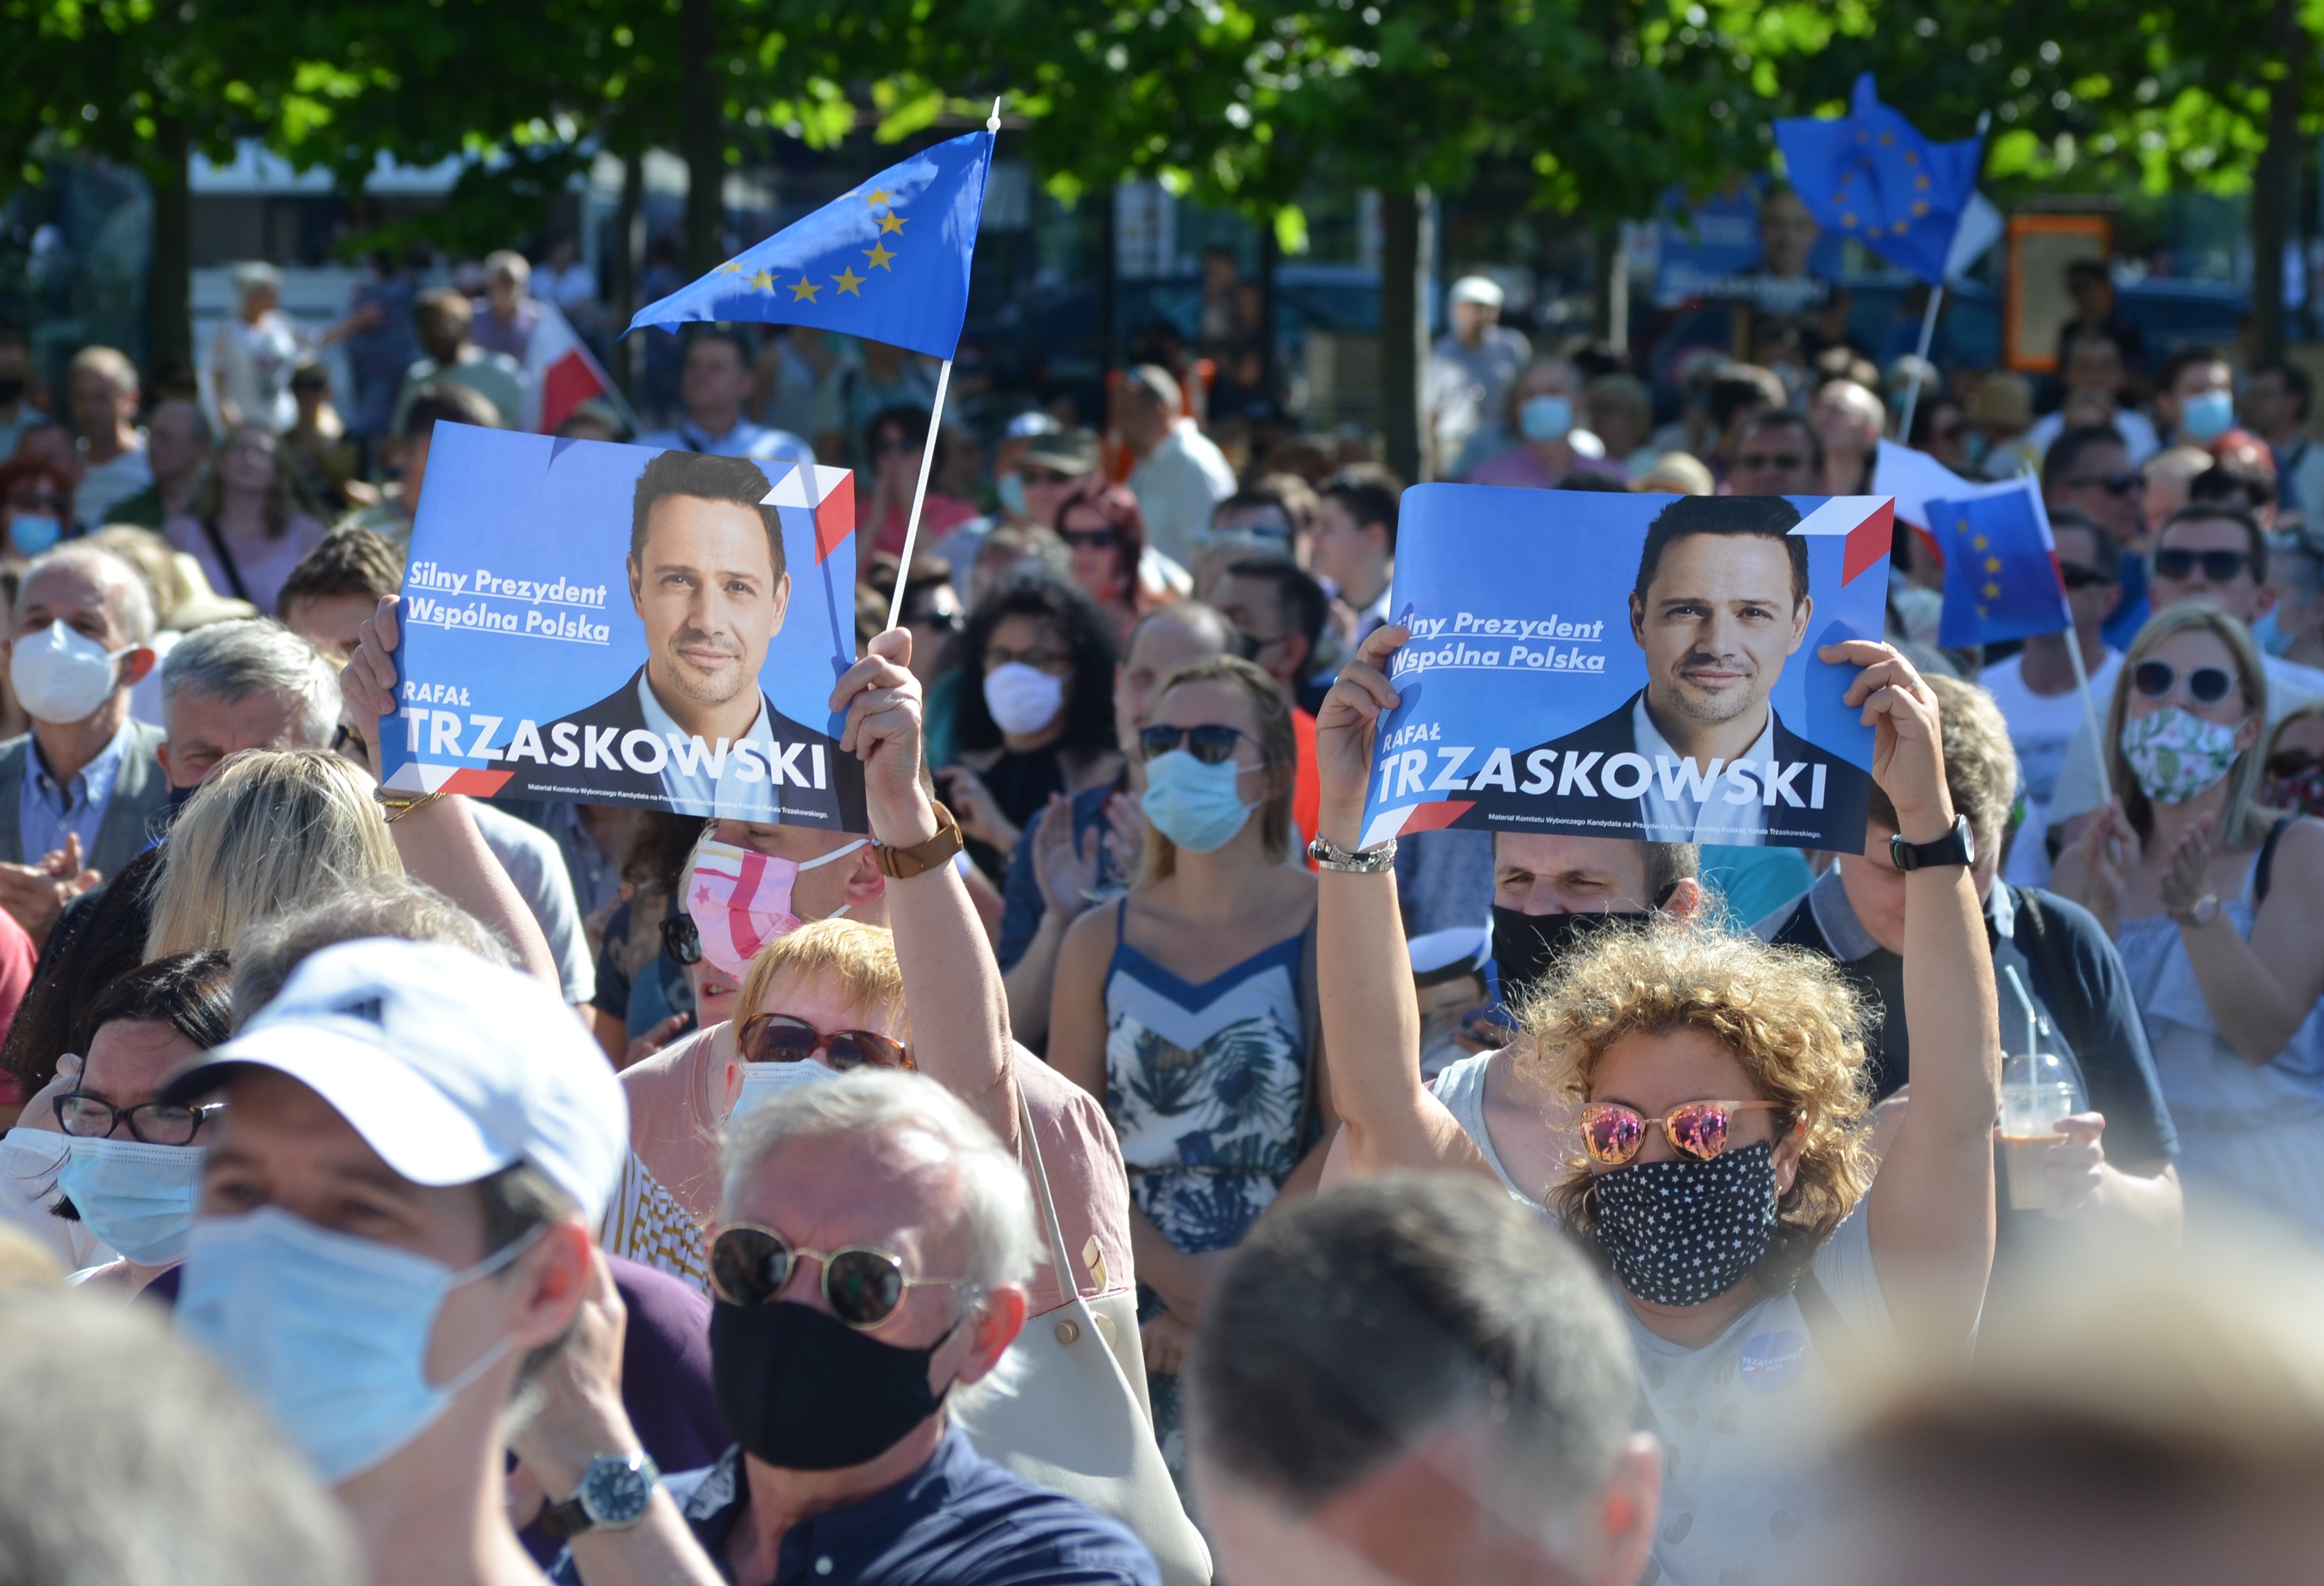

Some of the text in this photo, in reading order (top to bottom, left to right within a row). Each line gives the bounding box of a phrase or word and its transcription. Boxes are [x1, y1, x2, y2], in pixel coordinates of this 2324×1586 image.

[409, 561, 606, 605] Silny Prezydent
[408, 596, 609, 641] Wspólna Polska
[1454, 613, 1603, 641] Prezydent
[1392, 642, 1605, 674] Wspólna Polska
[402, 681, 471, 707] RAFAŁ
[400, 707, 826, 790] TRZASKOWSKI
[1382, 722, 1441, 754] RAFAŁ
[1379, 746, 1827, 809] TRZASKOWSKI
[1546, 817, 1585, 826] Wyborczego
[1587, 819, 1621, 828] Kandydata
[1633, 821, 1668, 830] Prezydenta
[1770, 829, 1822, 839] Trzaskowskiego.
[1742, 1352, 1801, 1367] TRZASKOWSKI
